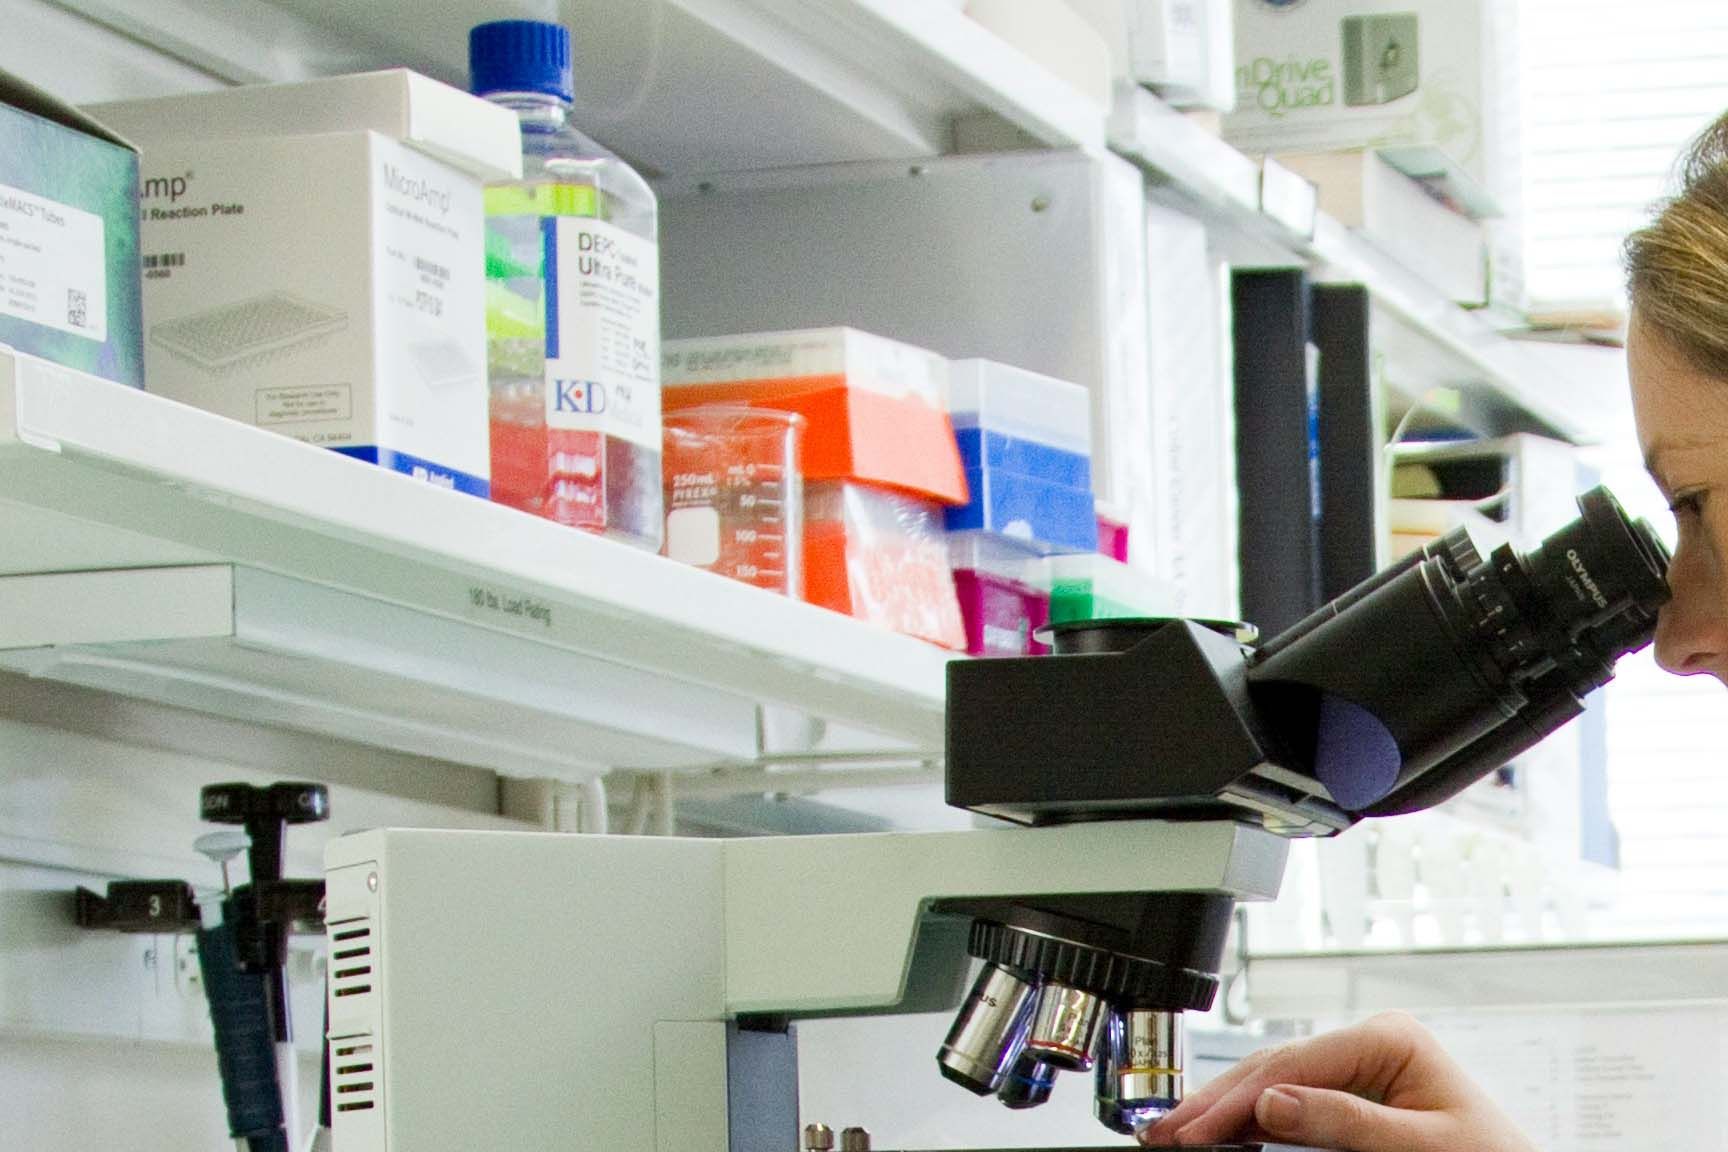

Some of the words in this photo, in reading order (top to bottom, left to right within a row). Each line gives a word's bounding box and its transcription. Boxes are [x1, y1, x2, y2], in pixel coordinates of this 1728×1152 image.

[1257, 77, 1334, 118] Quad
[150, 206, 208, 221] Reaction
[211, 203, 244, 216] Plate
[739, 494, 757, 508] 50
[735, 529, 758, 544] 100
[736, 564, 759, 578] 150
[1566, 549, 1608, 609] OLYMPUS
[150, 895, 161, 917] 3
